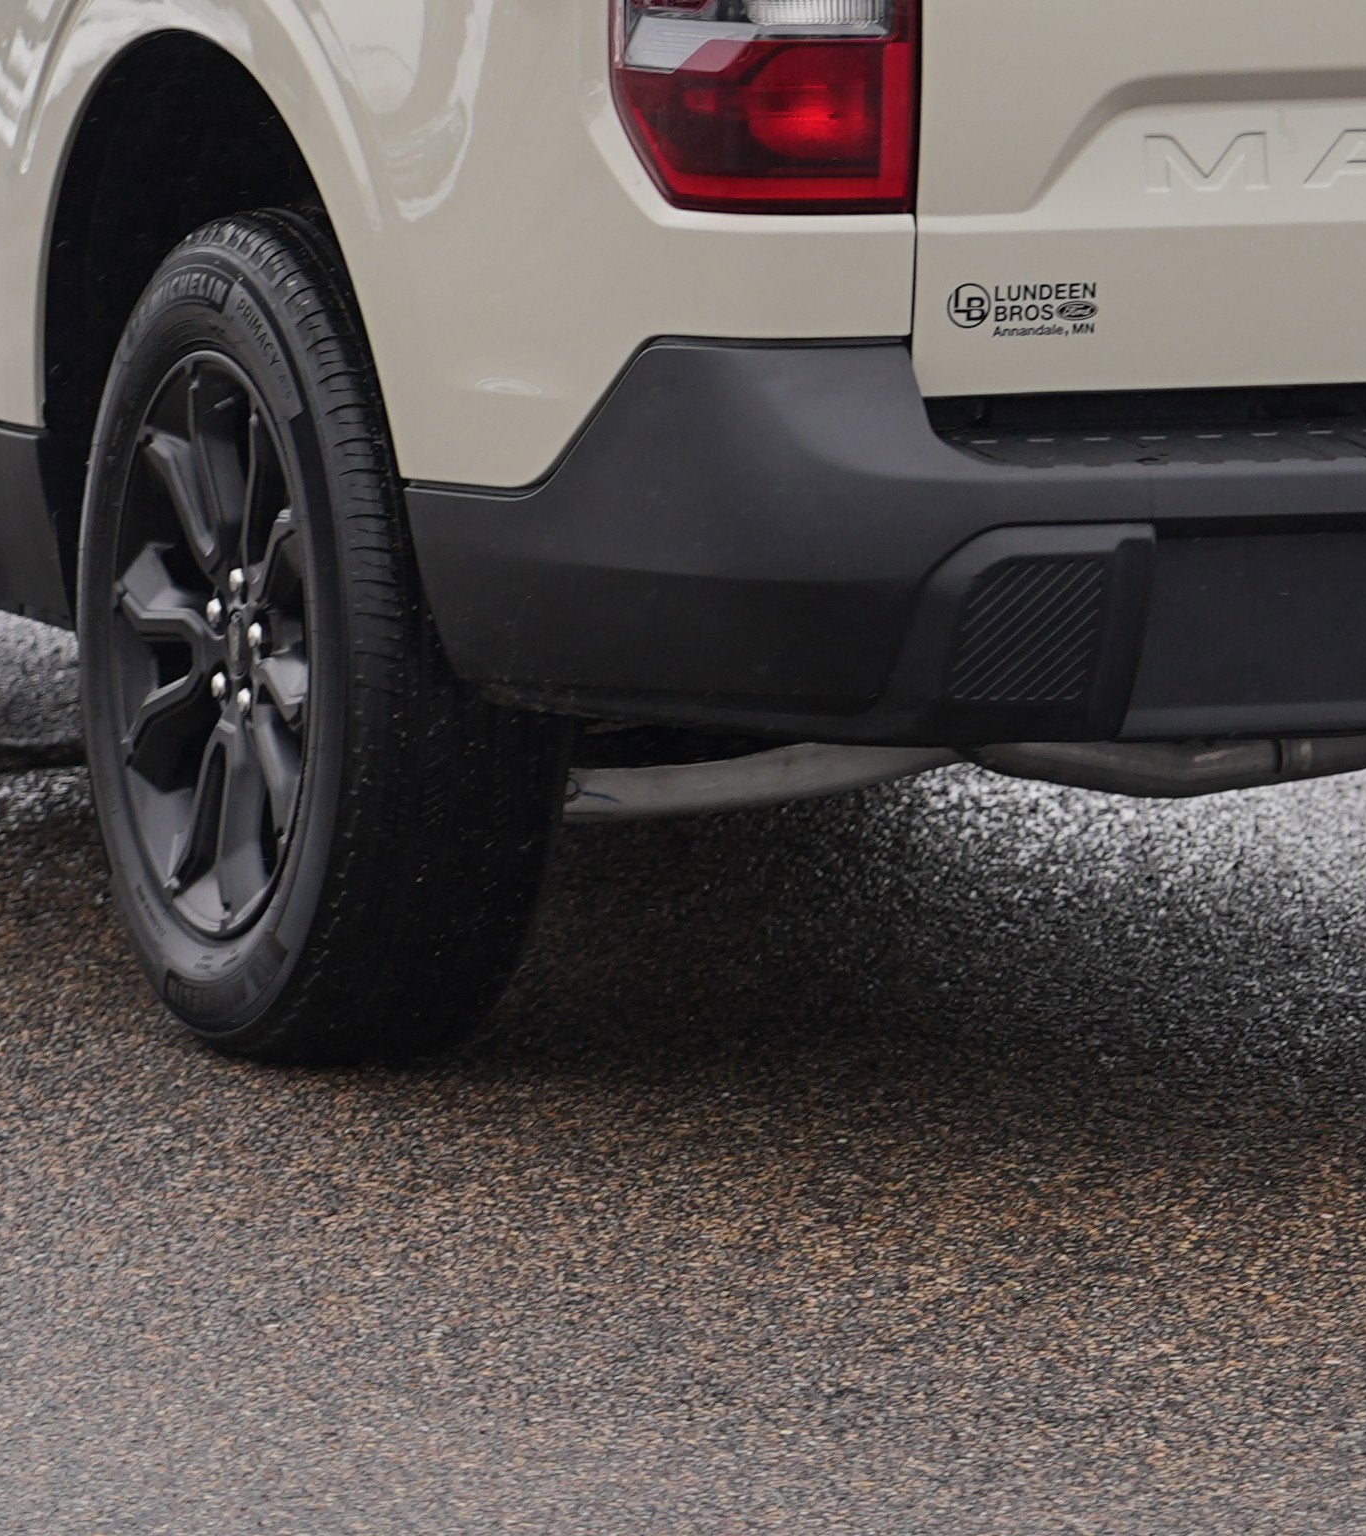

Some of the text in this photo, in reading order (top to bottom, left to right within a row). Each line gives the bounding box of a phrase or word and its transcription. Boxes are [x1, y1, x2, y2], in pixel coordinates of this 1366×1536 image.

[994, 283, 1096, 302] LUNDEEN
[994, 303, 1053, 322] BROS
[992, 322, 1095, 337] Annandale, MN
